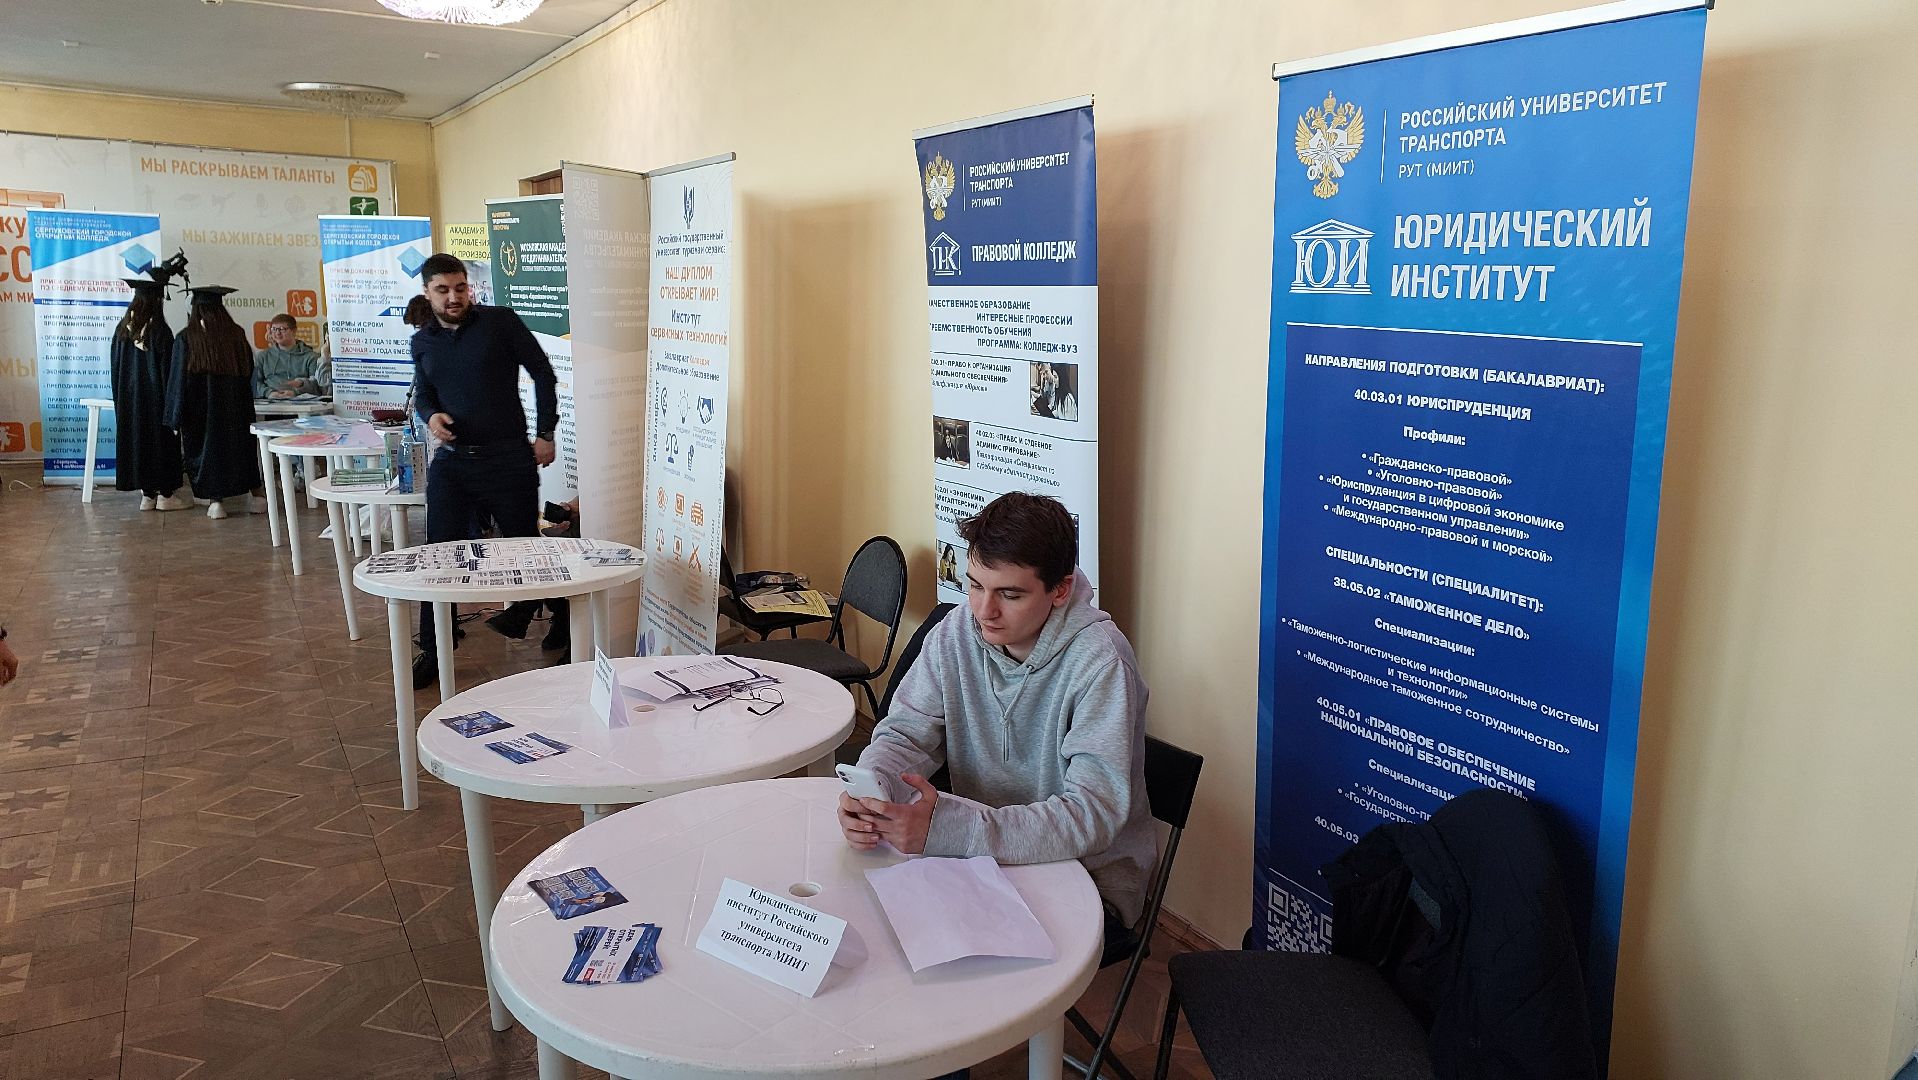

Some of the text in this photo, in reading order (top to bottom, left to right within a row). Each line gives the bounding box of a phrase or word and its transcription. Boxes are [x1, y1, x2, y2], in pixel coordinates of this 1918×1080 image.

[1400, 81, 1667, 130] РОССИЙСКИЙ УНИВЕРСИТЕТ
[1400, 127, 1506, 154] ТРАНСПОРТА
[141, 157, 335, 184] МЫ РАСКРЫВАЕМ ТАЛАНТЫ
[970, 152, 1070, 177] РОССИЙСКИЙ УНИВЕРСИТЕТ
[1398, 159, 1475, 179] РУТ (МИИТ)
[970, 177, 1013, 192] ТРАНСПОРТА
[971, 199, 981, 208] РУТ
[35, 227, 132, 238] СЕРПУХОВСКИЙ ГОРОДСКОЙ
[182, 229, 319, 247] МЫ ЗАЖИГАЕМ ЗВЕЗ
[450, 226, 485, 235] АКАДЕМИЯ
[1394, 196, 1652, 255] ЮРИДИЧЕСКИЙ
[458, 251, 492, 260] ПРОИЗВОД
[521, 254, 567, 264] ПРЕДПРИНИМАТЕЛЬС
[971, 239, 1077, 262] ПРАВОВОЙ КОЛЛЕДЖ
[1291, 237, 1370, 288] ЮИ
[665, 266, 713, 282] НАШ ДИПЛОМ
[1390, 265, 1555, 302] ИНСТИТУТ
[223, 298, 275, 308] ХНОВЛЯЕМ
[660, 286, 719, 301] ОТКРЫВАЕТ МИР!
[928, 299, 1031, 310] АЧЕСТВЕННОЕ ОБРАЗОВАНИЕ
[671, 309, 701, 328] Институт
[930, 323, 1032, 337] РЕЕМСТВЕННОСТЬ ОБУЧЕНИЯ
[976, 313, 1073, 325] ИНТЕРЕСНЫЕ ПРОФЕССИИ
[651, 328, 728, 345] сервисных технологий
[977, 338, 1078, 354] ПРОГРАММА: КОЛЛЕДЖ-ВУЗ
[972, 362, 1012, 373] ОРГАНИЗАЦИЯ
[1305, 353, 1605, 394] НАПРАВЛЕНИЯ ПОДГОТОВКИ (БАКАЛАВРИАТ):
[1354, 388, 1531, 422] 40.03.01 ЮРИСПРУДЕНЦИЯ
[1403, 426, 1466, 447] Профили:
[1368, 452, 1512, 486] «Гражданско-правовой»
[1375, 469, 1503, 500] «Уголовно-правовой»
[1326, 475, 1565, 532] «Юриспруденция в цифровой экономике
[1343, 493, 1530, 541] и государственном управлении»
[1331, 503, 1553, 564] «Международно-правовой и морской»
[1326, 545, 1544, 613] СПЕЦИАЛЬНОСТИ (СПЕЦИАЛИТЕТ):
[1333, 576, 1530, 641] 38.05.02 «ТАМОЖЕННОЕ ДЕЛО»
[1374, 617, 1476, 657] Специализации:
[1287, 618, 1599, 733] «Таможенно-логистические информационные системы
[1387, 666, 1468, 700] и технологии»
[1303, 650, 1571, 755] «Международное таможенное сотрудничество»
[1316, 696, 1536, 792] 40.05.01 «ПРАВОВОЕ ОБЕСПЕЧЕНИЕ
[1320, 711, 1414, 757] НАЦИОНАЛЬНОЙ
[1368, 758, 1458, 801] Специализаци
[1344, 790, 1416, 824] «Государст
[1361, 784, 1432, 821] «Уголовно-п
[1314, 815, 1359, 845] 40.05.03
[748, 887, 818, 923] Юридический
[726, 897, 830, 946] институт Российского
[737, 919, 803, 953] университета
[720, 928, 810, 973] транспорта МИИТ
